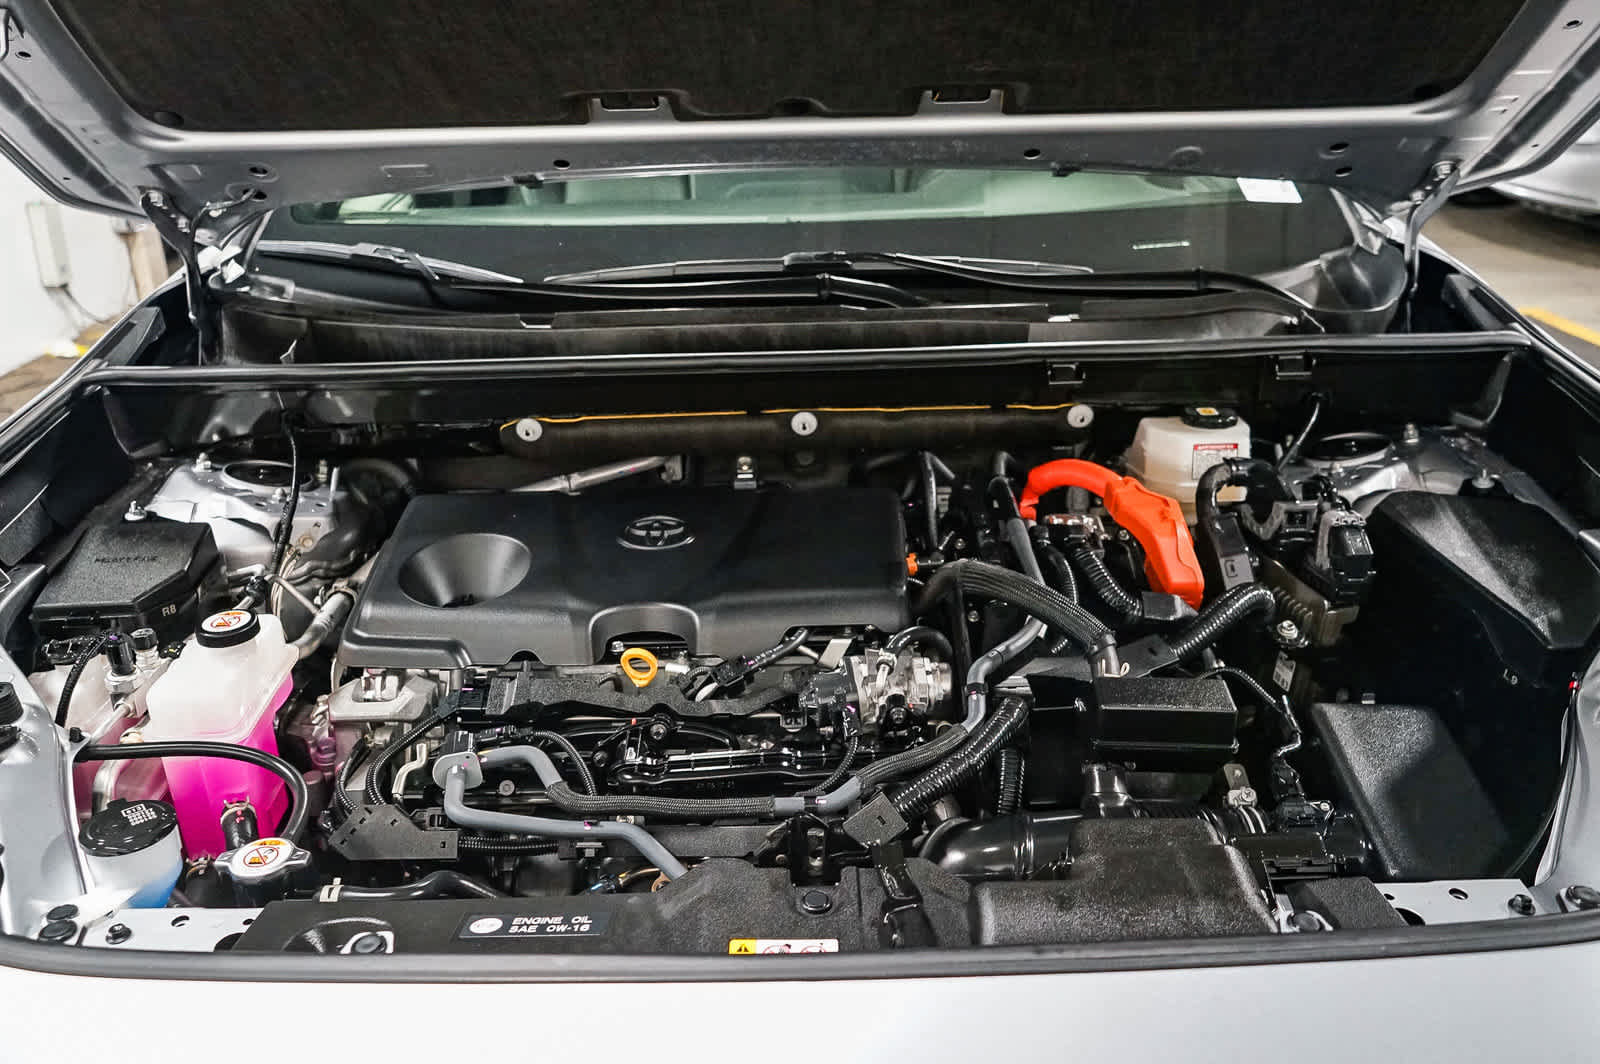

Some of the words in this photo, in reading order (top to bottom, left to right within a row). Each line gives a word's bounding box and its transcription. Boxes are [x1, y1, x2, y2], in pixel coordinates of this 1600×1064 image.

[162, 604, 176, 616] R8
[511, 916, 564, 925] ENGINE
[571, 915, 593, 924] OIL
[508, 925, 538, 933] SAE
[546, 924, 590, 933] 0W-16
